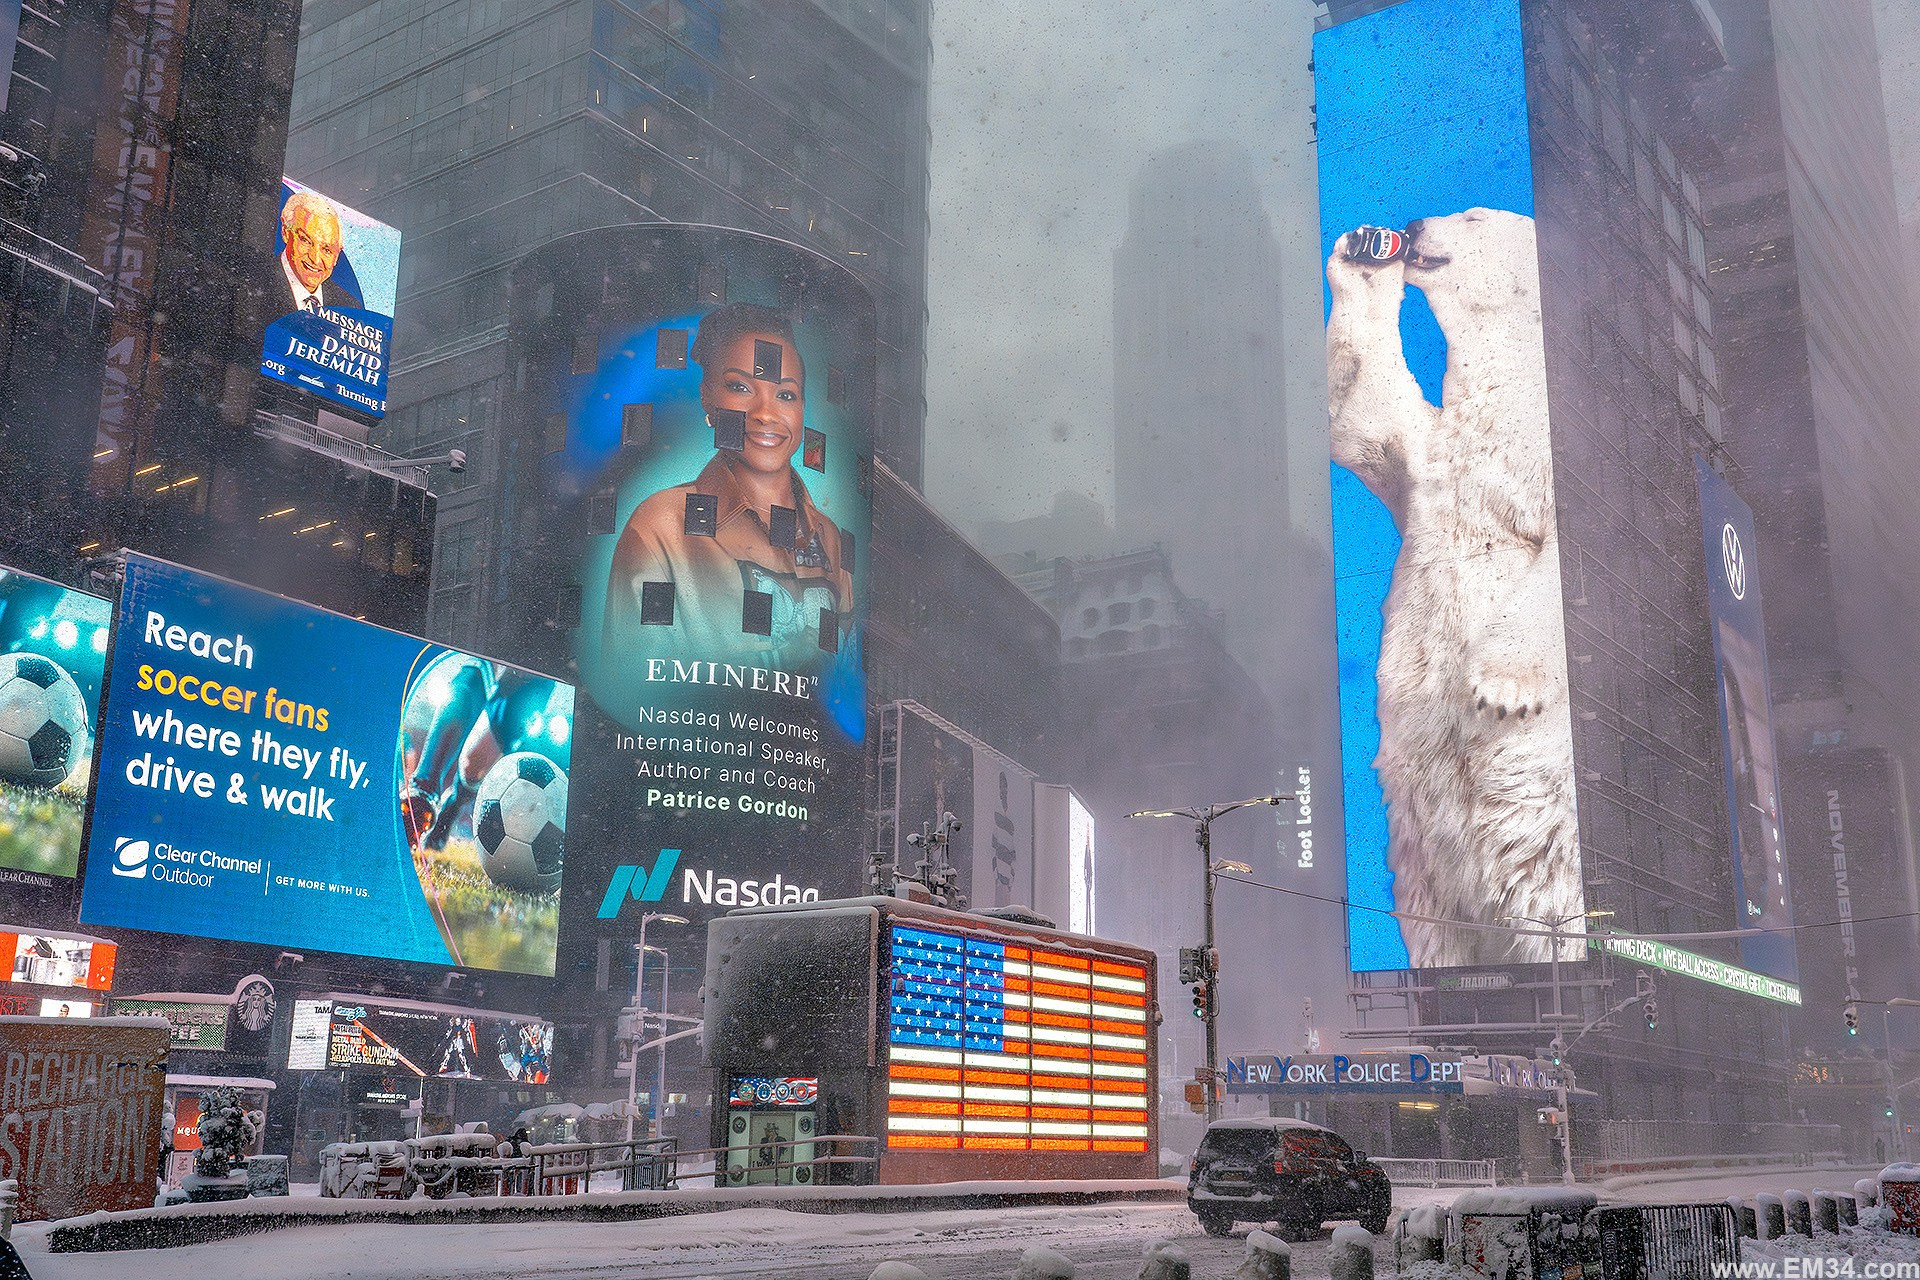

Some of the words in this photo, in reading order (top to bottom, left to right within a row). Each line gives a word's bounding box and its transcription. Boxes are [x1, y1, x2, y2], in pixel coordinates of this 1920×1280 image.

[304, 300, 314, 314] A
[317, 306, 383, 342] MESSAGE
[340, 327, 382, 354] FROM
[285, 336, 380, 386] JEREMIAH
[321, 335, 382, 371] DAVID
[262, 360, 286, 375] .org
[336, 384, 379, 411] Turning
[144, 610, 254, 669] Reach
[137, 664, 256, 714] soccer
[265, 687, 329, 732] fans
[639, 707, 720, 730] Nasdaq
[729, 712, 819, 742] Welcomes
[132, 709, 241, 756] where
[252, 729, 322, 779] they
[329, 746, 370, 789] fly,
[617, 734, 752, 757] International
[761, 743, 830, 774] Speaker,
[126, 752, 215, 798] drive
[226, 772, 249, 805] &
[260, 785, 335, 821] walk
[637, 761, 711, 780] Author
[719, 768, 755, 784] and
[763, 771, 816, 794] Coach
[1295, 767, 1312, 824] Locker
[647, 789, 730, 811] Patrice
[738, 795, 808, 820] Gordon
[154, 843, 197, 864] Clear
[199, 850, 262, 874] Channel
[1298, 830, 1313, 868] Foot
[152, 864, 214, 888] Outdoor
[275, 875, 295, 887] GET
[297, 878, 326, 891] MORE
[328, 883, 353, 895] WITH
[355, 887, 371, 898] US.
[683, 868, 819, 906] Nasdaq
[1827, 790, 1855, 957] NOVEMBER
[1637, 940, 1657, 964] DECK
[1662, 947, 1677, 969] NYE
[1677, 952, 1693, 973] BALL
[1694, 957, 1719, 982] ACCESS
[1723, 967, 1748, 989] CRYSTAL
[1748, 974, 1761, 993] GIFT
[331, 1043, 360, 1057] STRIKE
[362, 1045, 399, 1060] GUNDAM
[1226, 1056, 1272, 1083] NEW
[1274, 1055, 1328, 1083] YORK
[1334, 1055, 1401, 1083] POLICE
[1409, 1054, 1463, 1083] DEPT
[2, 1051, 153, 1109] RECHARGE
[0, 1095, 152, 1186] STATION
